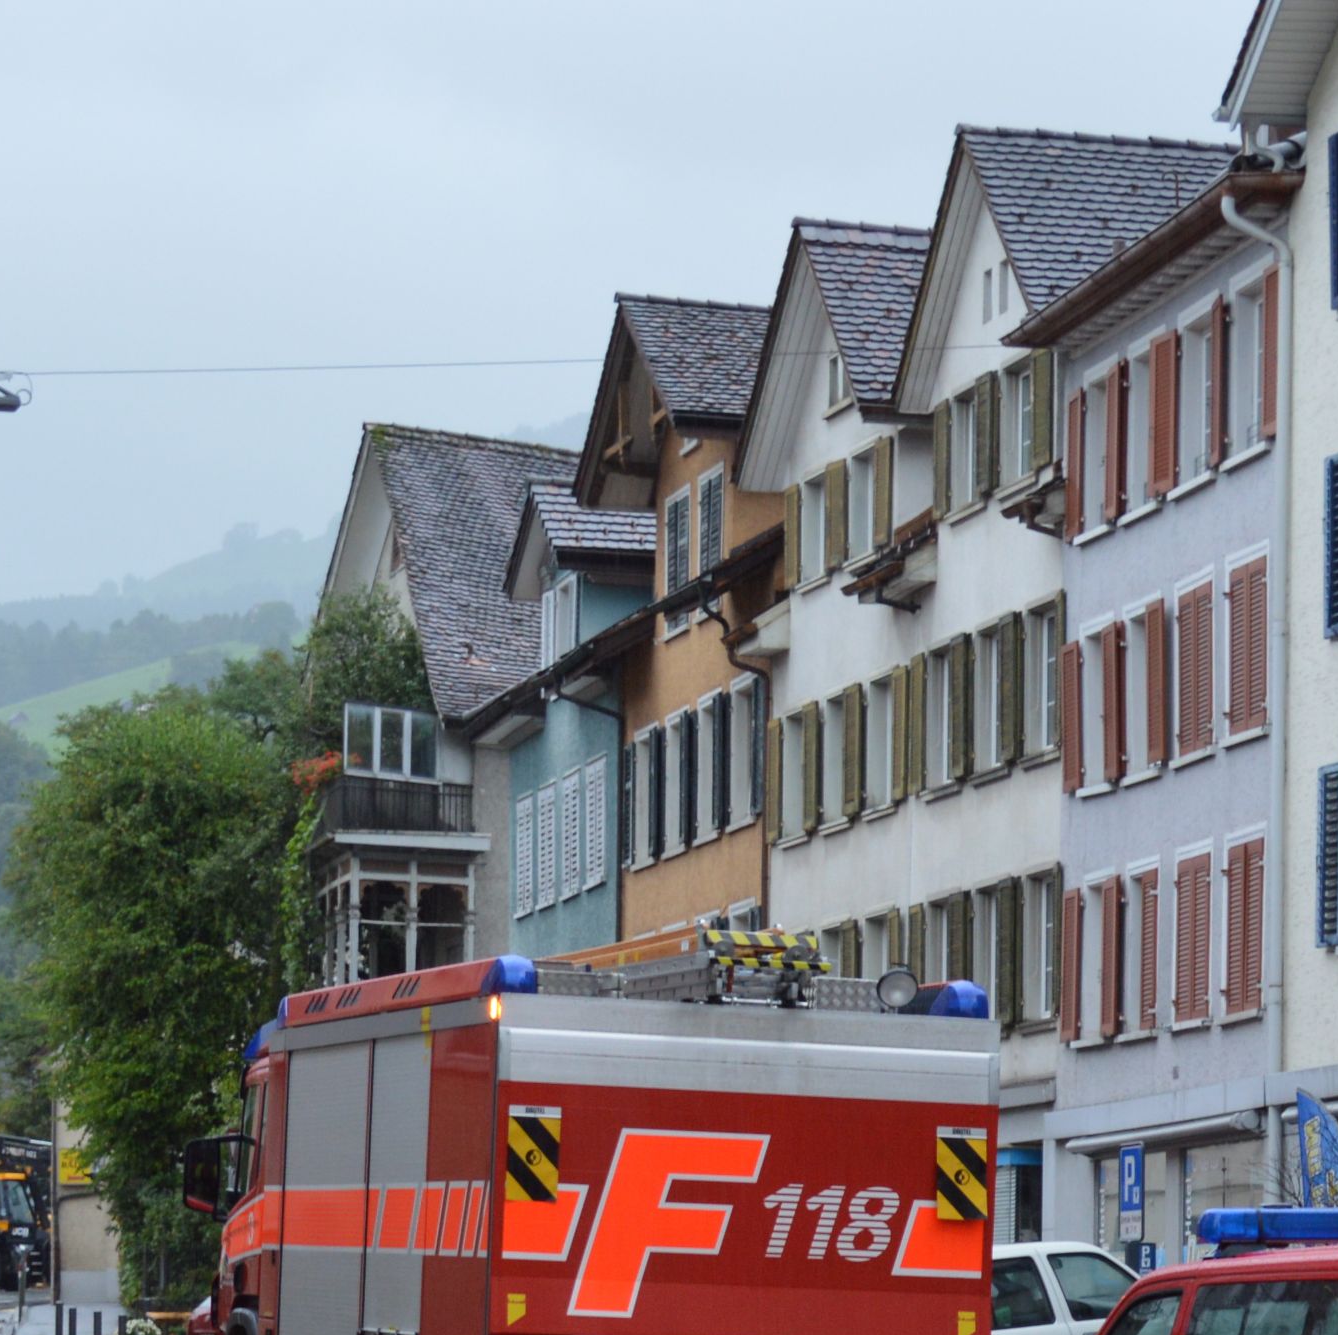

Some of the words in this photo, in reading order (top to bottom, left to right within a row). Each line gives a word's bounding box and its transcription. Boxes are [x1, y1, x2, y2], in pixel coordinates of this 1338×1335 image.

[1124, 1155, 1136, 1203] P
[566, 1127, 772, 1319] F
[763, 1183, 900, 1263] 118
